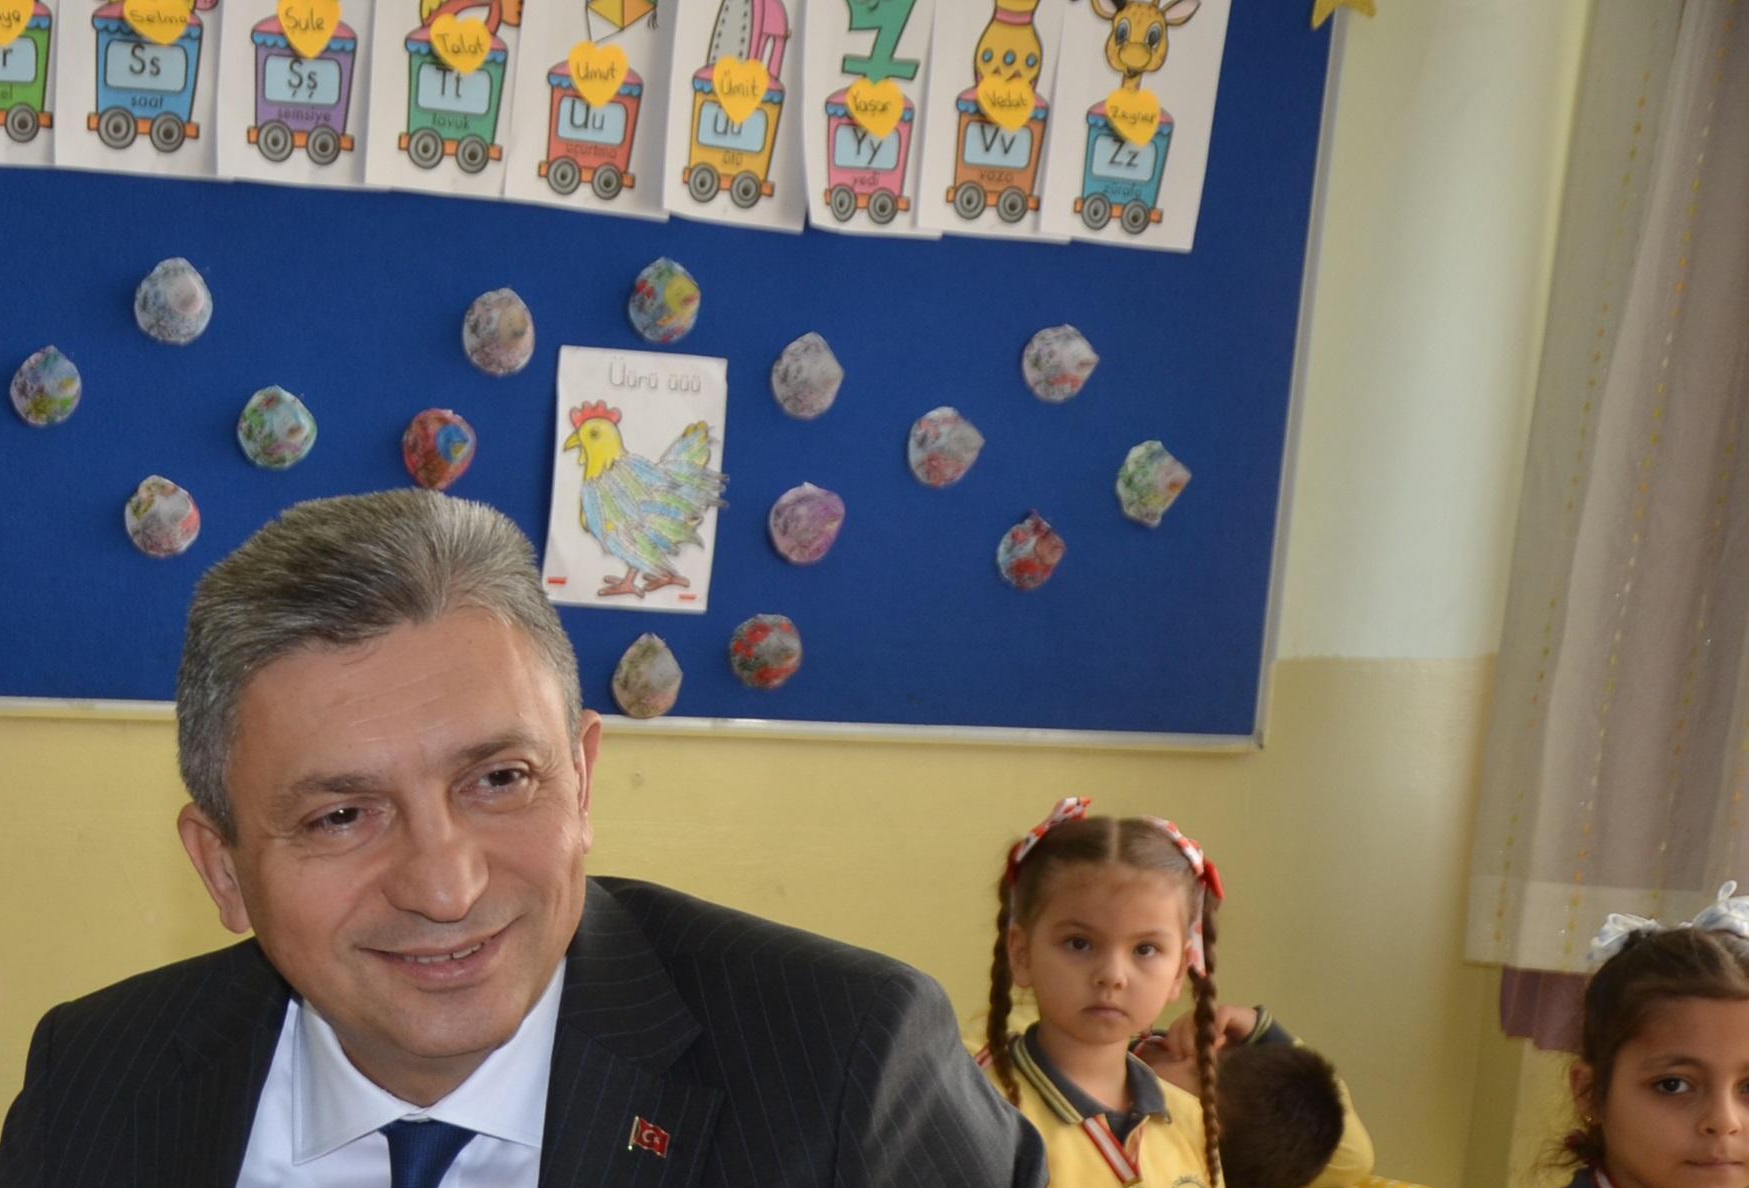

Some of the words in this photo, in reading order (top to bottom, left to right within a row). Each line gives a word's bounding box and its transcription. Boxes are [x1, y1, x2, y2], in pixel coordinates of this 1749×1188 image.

[129, 43, 160, 76] Ss
[435, 33, 485, 54] Talat
[287, 58, 318, 98] Şş
[435, 65, 462, 98] Tt
[570, 98, 606, 130] Uu
[852, 126, 883, 166] Yy
[980, 124, 1016, 155] Vv
[1108, 137, 1140, 168] Zz
